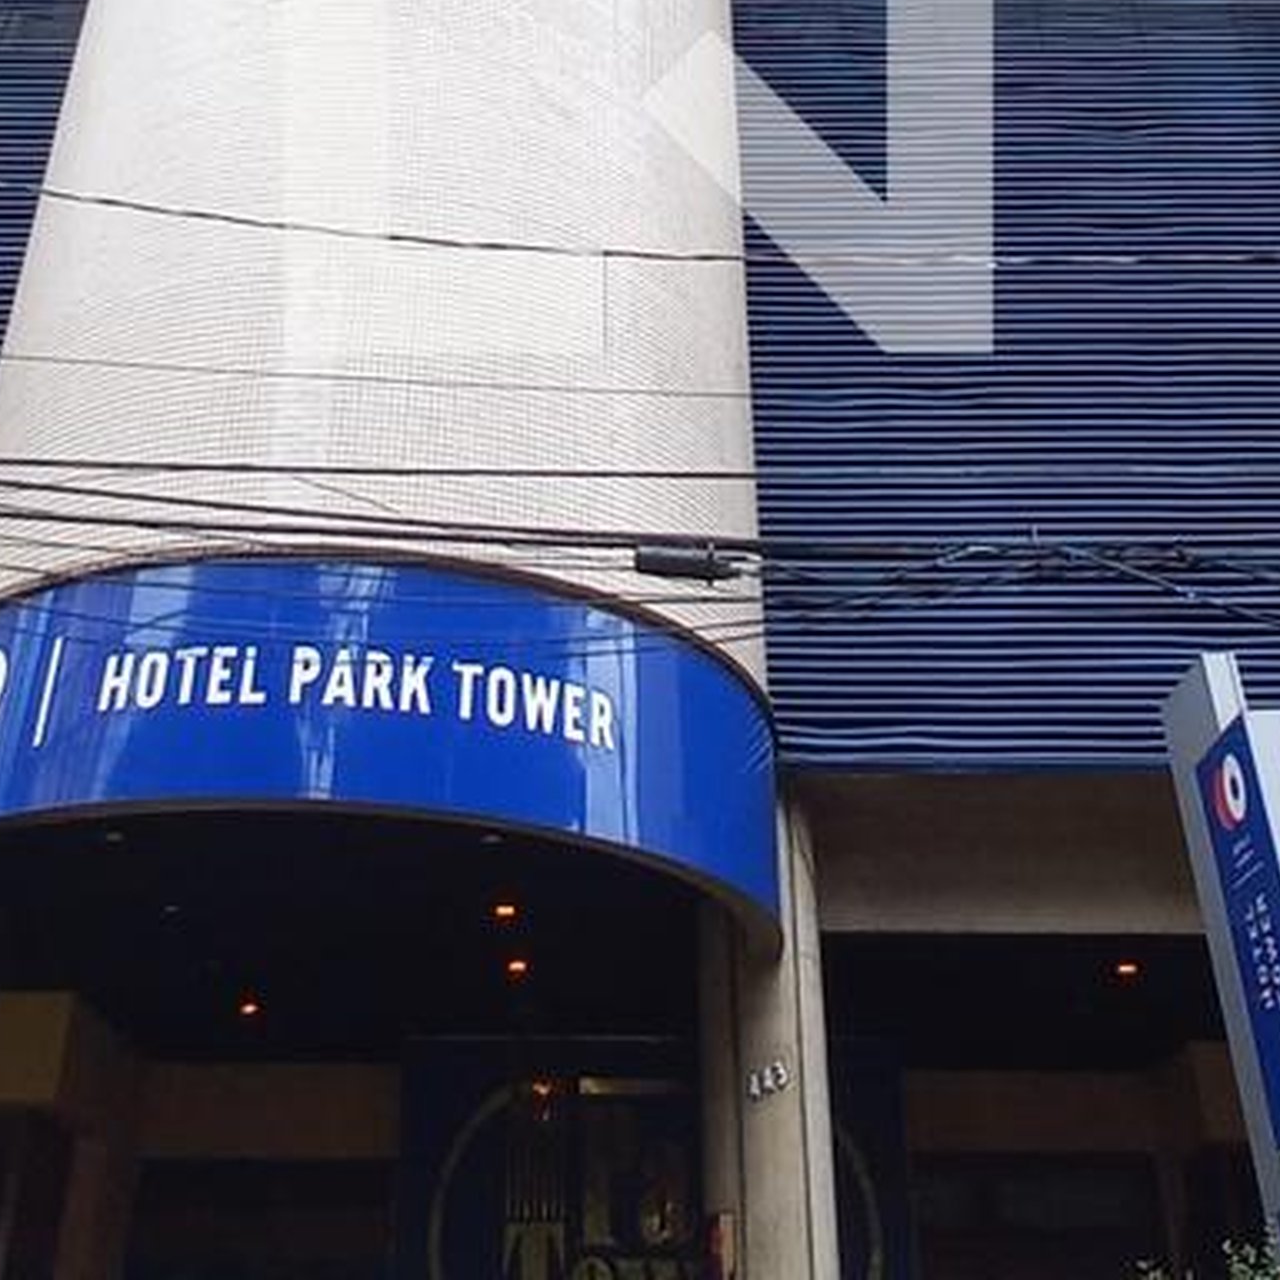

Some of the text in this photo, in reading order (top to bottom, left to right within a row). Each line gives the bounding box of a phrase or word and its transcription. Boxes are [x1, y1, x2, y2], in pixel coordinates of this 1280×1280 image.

[97, 644, 616, 751] HOTEL PARK TOWER
